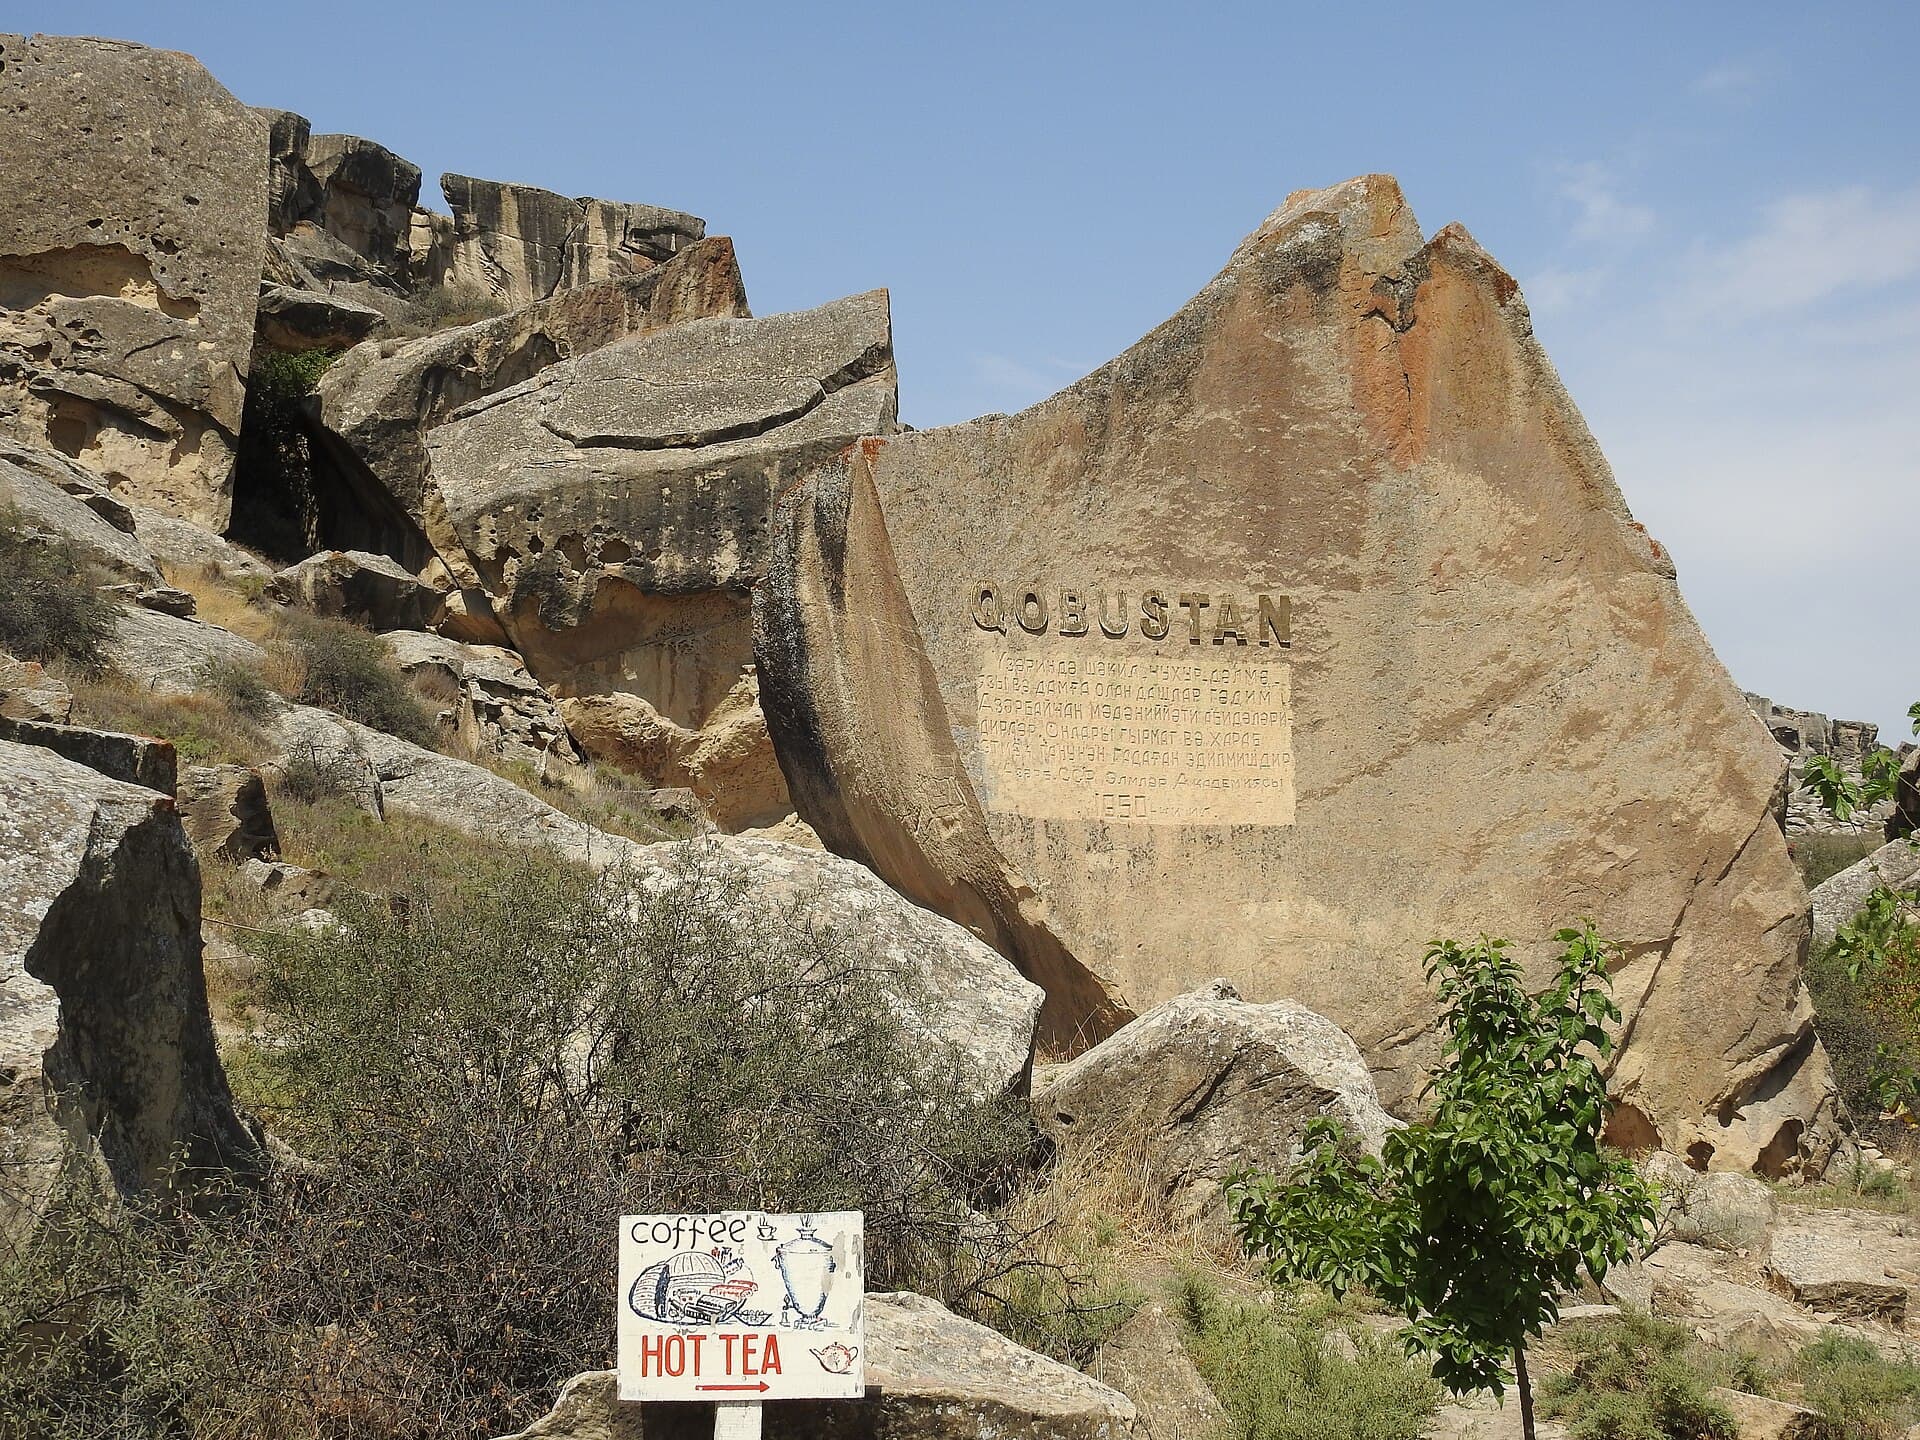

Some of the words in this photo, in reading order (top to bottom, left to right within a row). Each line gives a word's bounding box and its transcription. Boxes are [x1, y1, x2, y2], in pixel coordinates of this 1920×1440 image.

[970, 579, 1291, 648] QOBUSTAN
[631, 1217, 746, 1249] coffee
[641, 1334, 707, 1378] HOT
[719, 1333, 782, 1375] TEA
